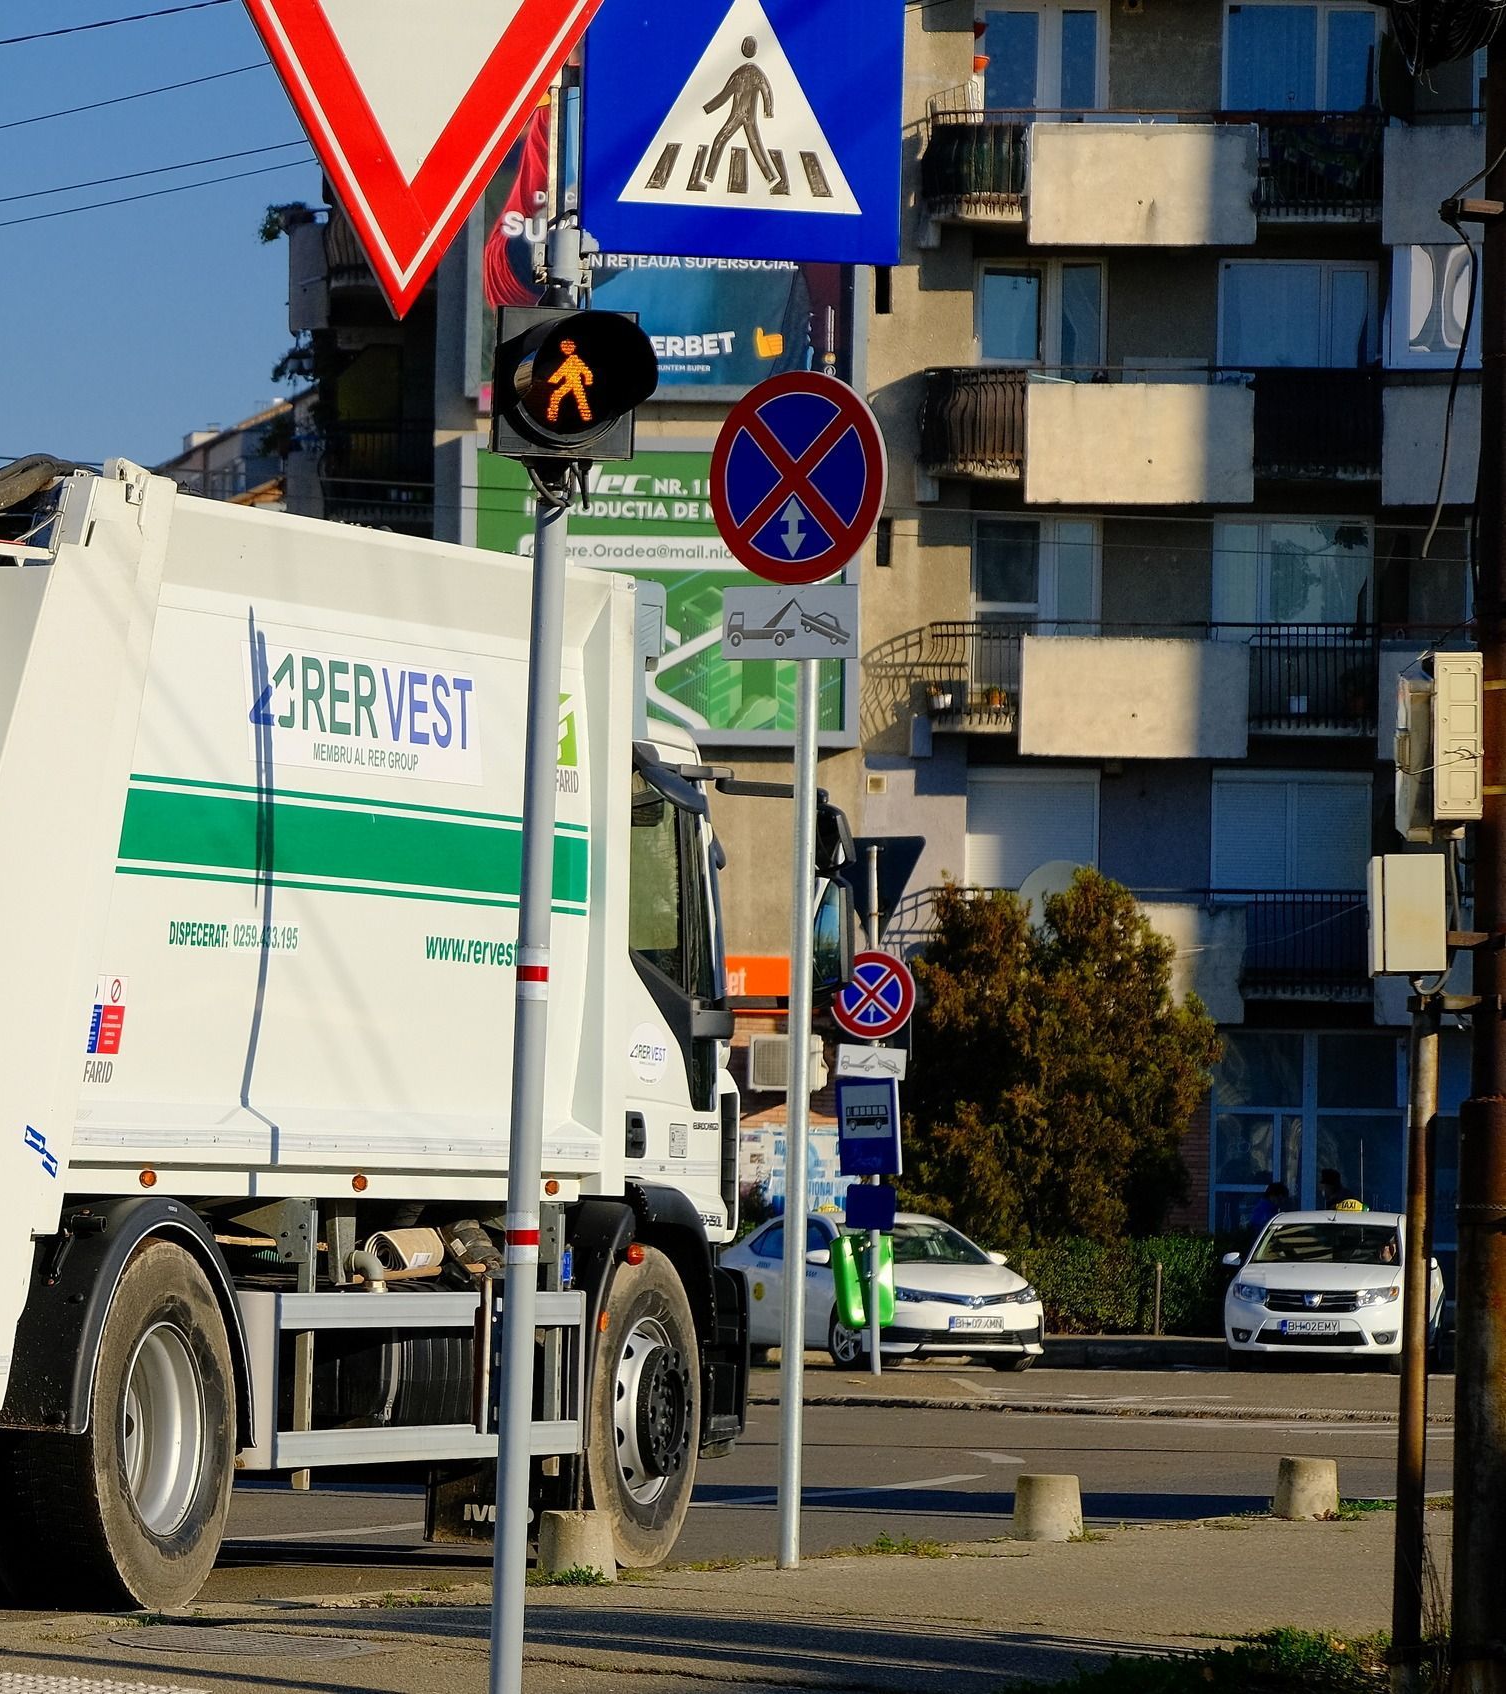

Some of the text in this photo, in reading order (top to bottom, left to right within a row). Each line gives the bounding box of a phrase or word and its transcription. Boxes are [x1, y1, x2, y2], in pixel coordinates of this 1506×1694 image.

[650, 331, 736, 357] ERBET
[654, 478, 689, 496] NR.
[674, 501, 700, 519] DE
[313, 742, 419, 772] MEMBRU AL RER GROUP
[425, 932, 520, 968] www.rervest
[82, 1060, 114, 1084] FARID
[1341, 1200, 1357, 1209] TAXI
